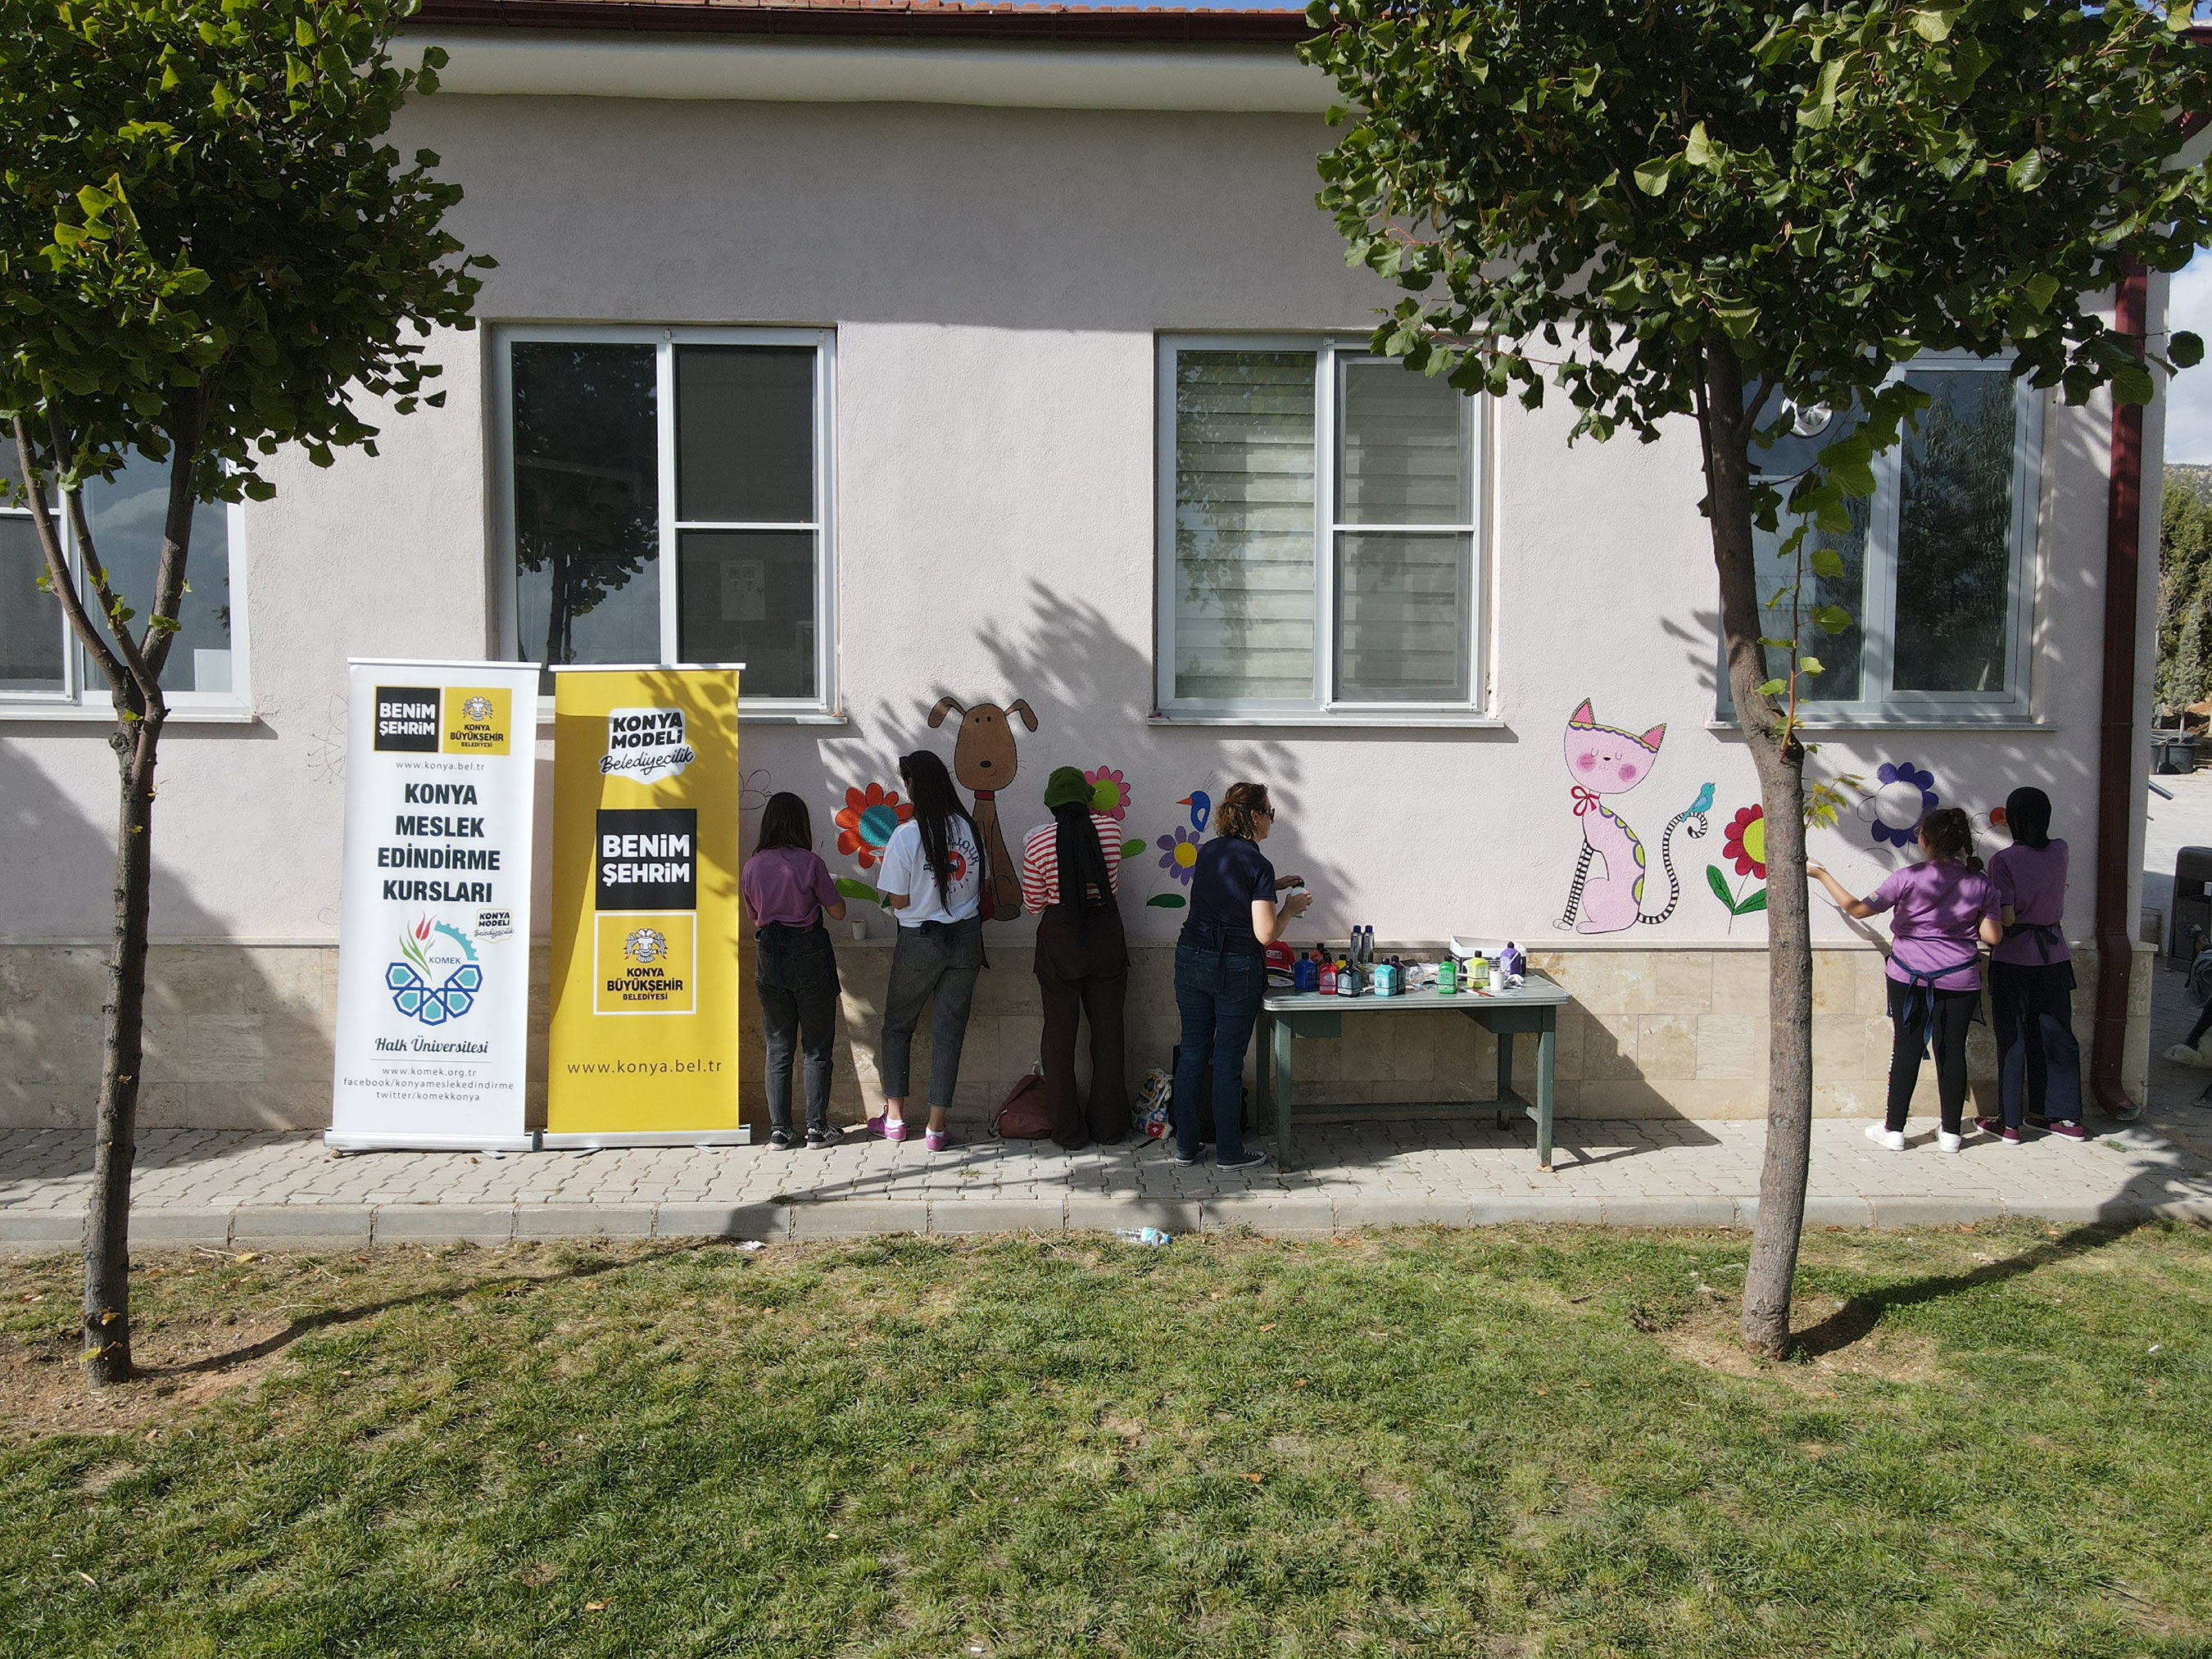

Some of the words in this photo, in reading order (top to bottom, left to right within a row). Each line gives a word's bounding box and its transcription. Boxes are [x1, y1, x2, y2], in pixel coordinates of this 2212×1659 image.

[464, 723, 491, 732] KONYA
[612, 712, 683, 733] KONYA
[450, 730, 504, 742] BÜYÜKŞEHİR
[396, 760, 485, 772] www.konya.bel.tr
[600, 746, 695, 776] Belediyecilik
[405, 782, 478, 805] KONYA
[395, 815, 485, 838] MESLEK
[378, 842, 501, 871] EDİNDİRME
[383, 879, 492, 903] KURSLARI
[478, 912, 510, 920] KONYA
[428, 956, 461, 964] KOMEK
[626, 968, 664, 977] KONYA
[606, 977, 683, 993] BÜYÜKŞEHİR
[623, 992, 669, 1001] BELEDİYESİ
[374, 1036, 407, 1052] Halk
[410, 1035, 489, 1054] Üniversitesi
[382, 1067, 477, 1078] www.komek.org.tr
[567, 1058, 722, 1077] www.konya.bel.tr
[343, 1077, 514, 1090] facebook/konyameslekedindirme
[376, 1090, 480, 1102] twitter/komekkonya
